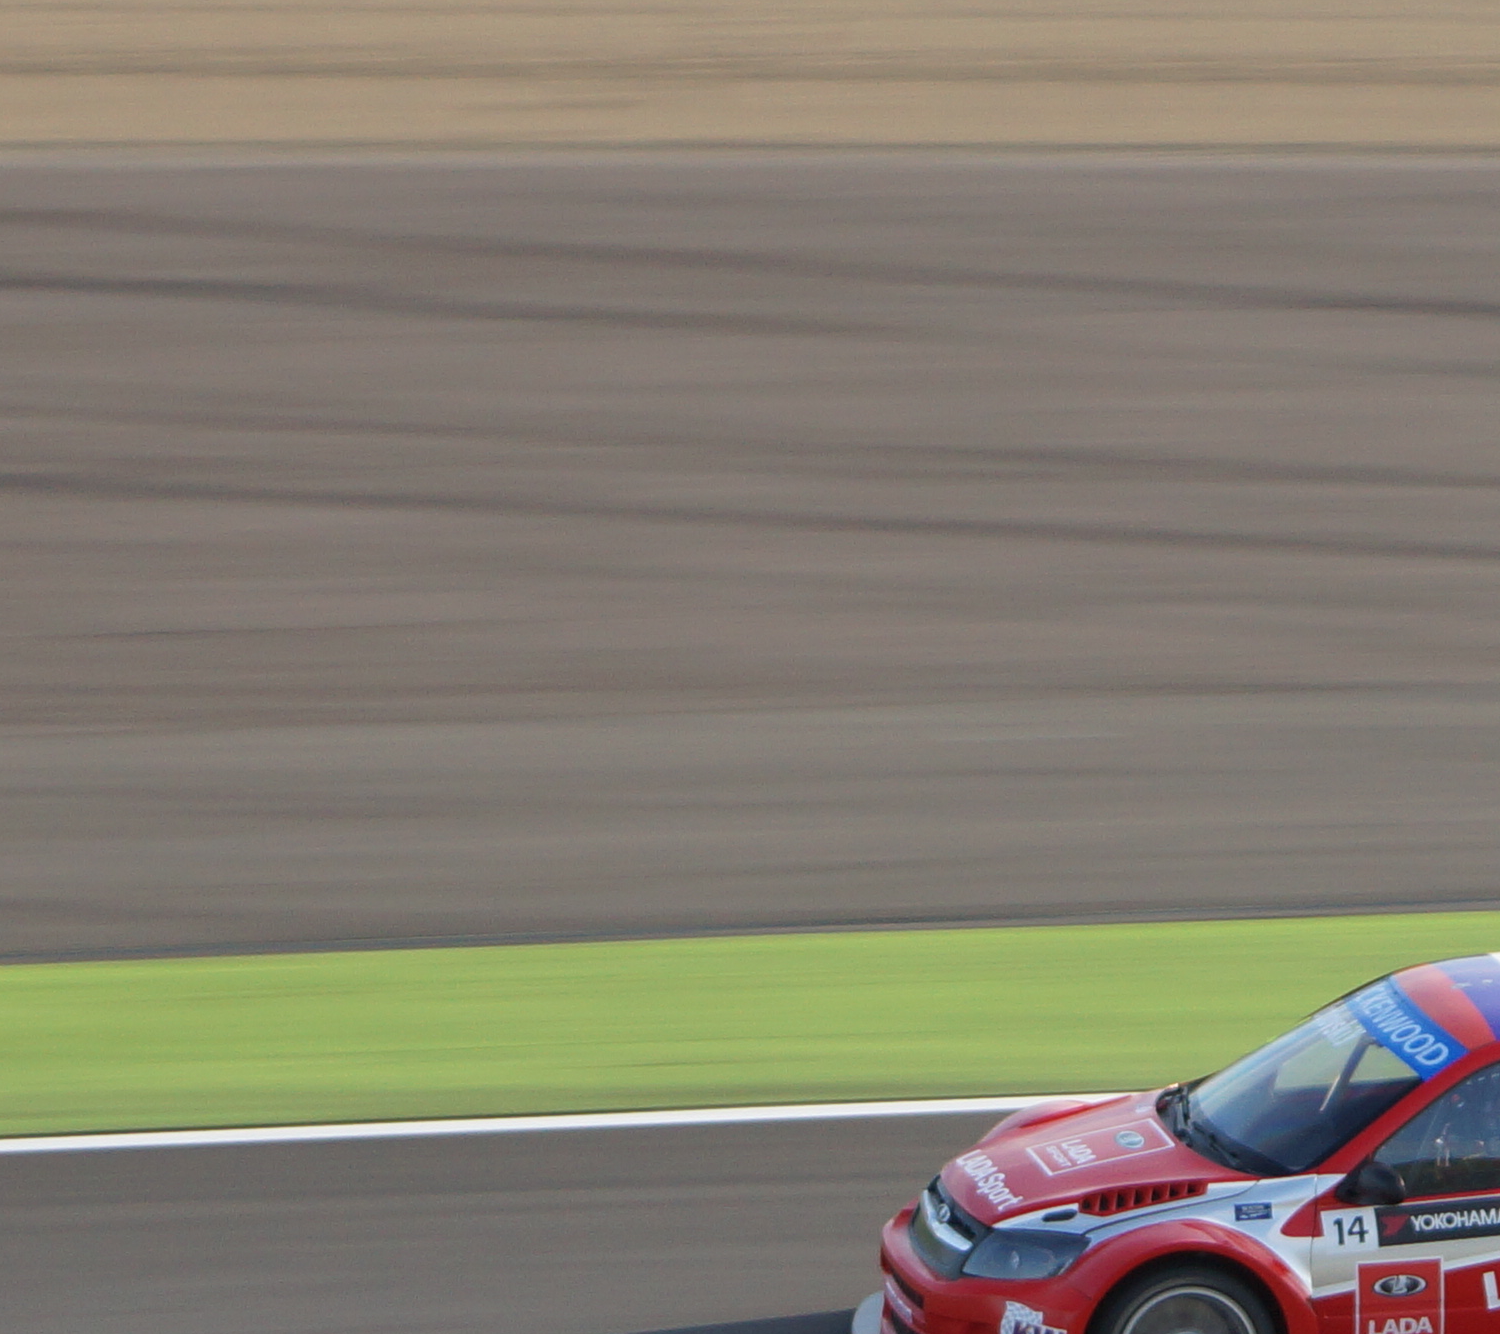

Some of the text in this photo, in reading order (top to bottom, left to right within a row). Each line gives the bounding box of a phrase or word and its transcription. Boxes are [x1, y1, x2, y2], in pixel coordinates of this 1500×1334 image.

[956, 1149, 1024, 1212] LADA Sport
[1333, 1216, 1369, 1246] 14
